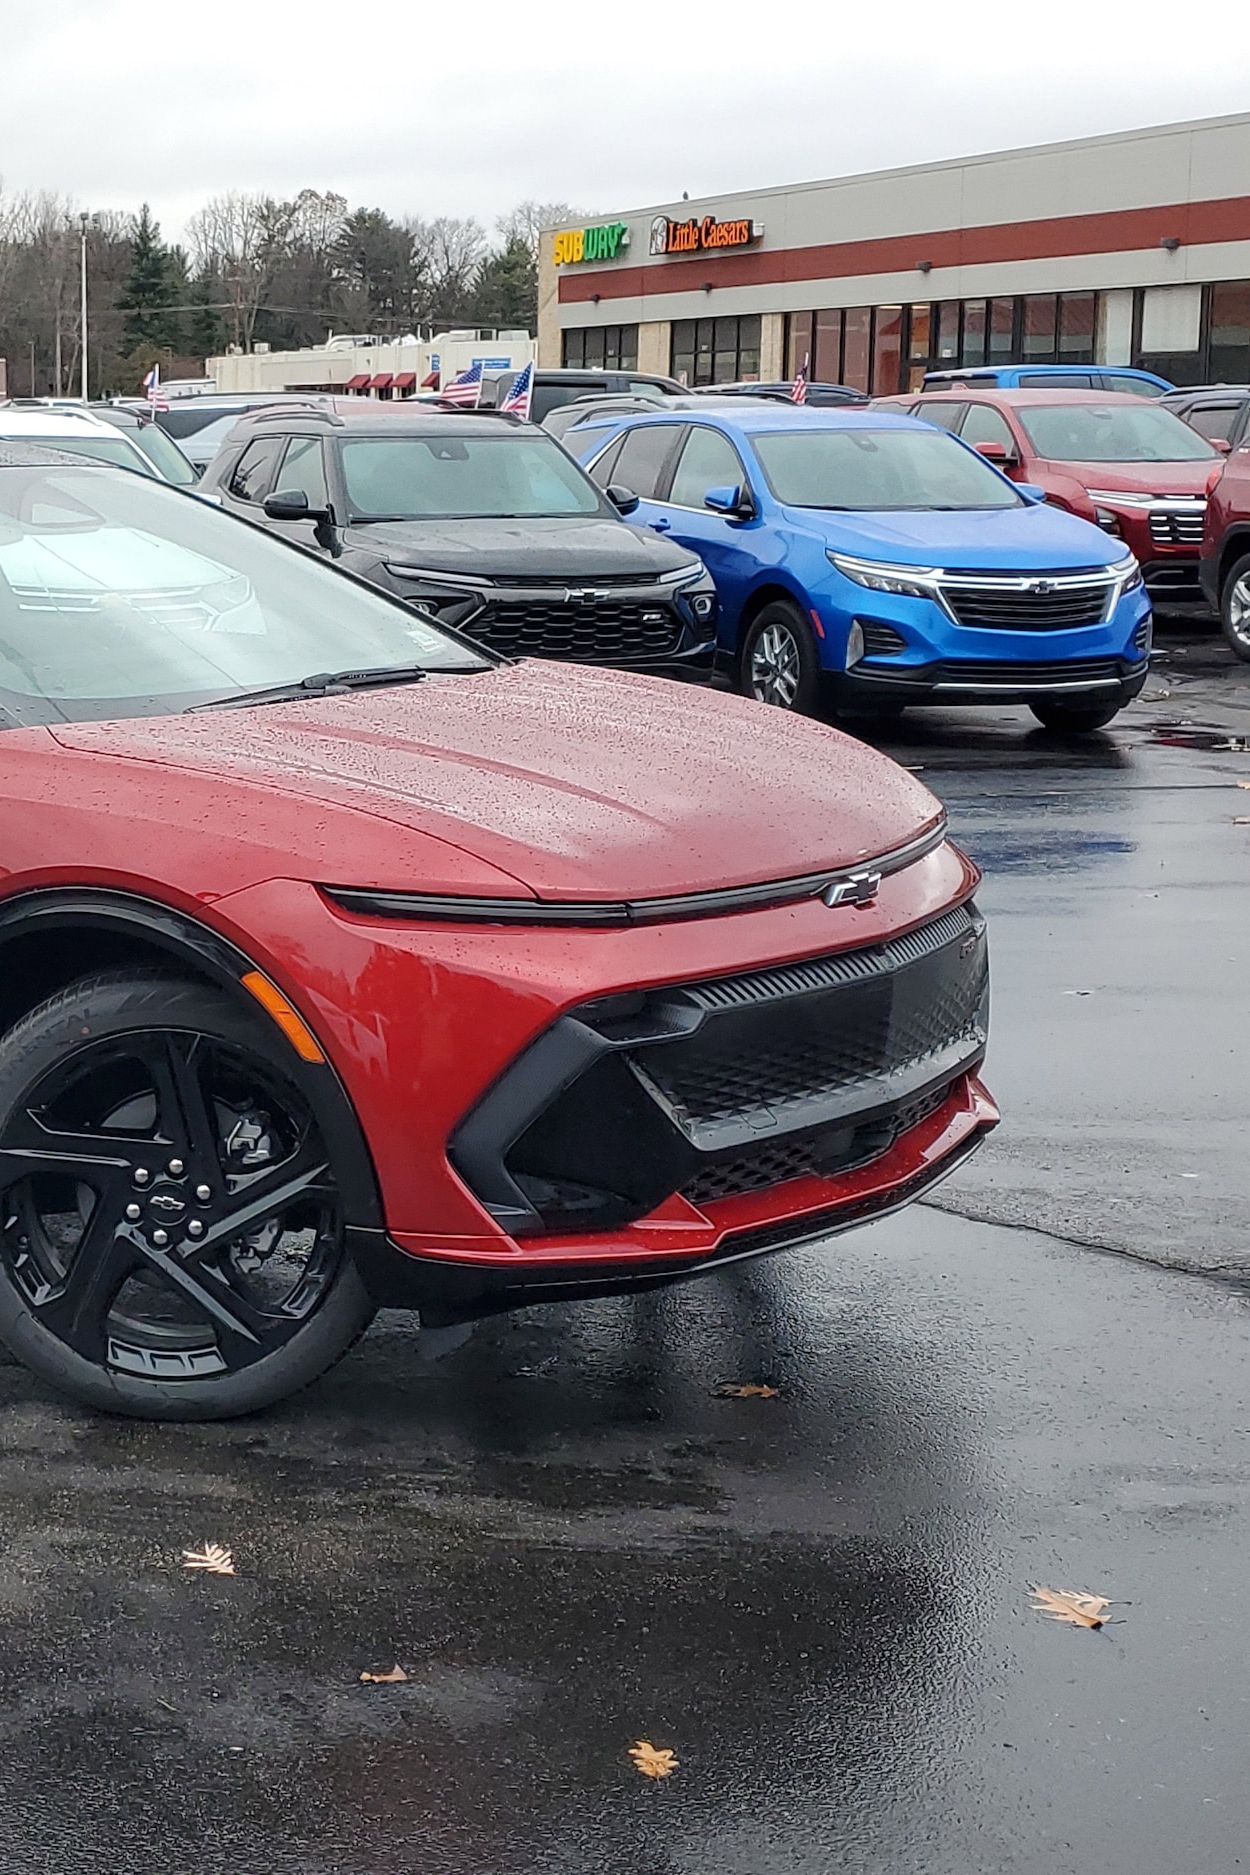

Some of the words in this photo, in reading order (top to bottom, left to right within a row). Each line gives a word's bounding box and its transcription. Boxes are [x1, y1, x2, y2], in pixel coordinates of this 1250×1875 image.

[553, 222, 624, 265] SUBWAY
[668, 219, 699, 251] Little
[701, 217, 749, 247] Caesars
